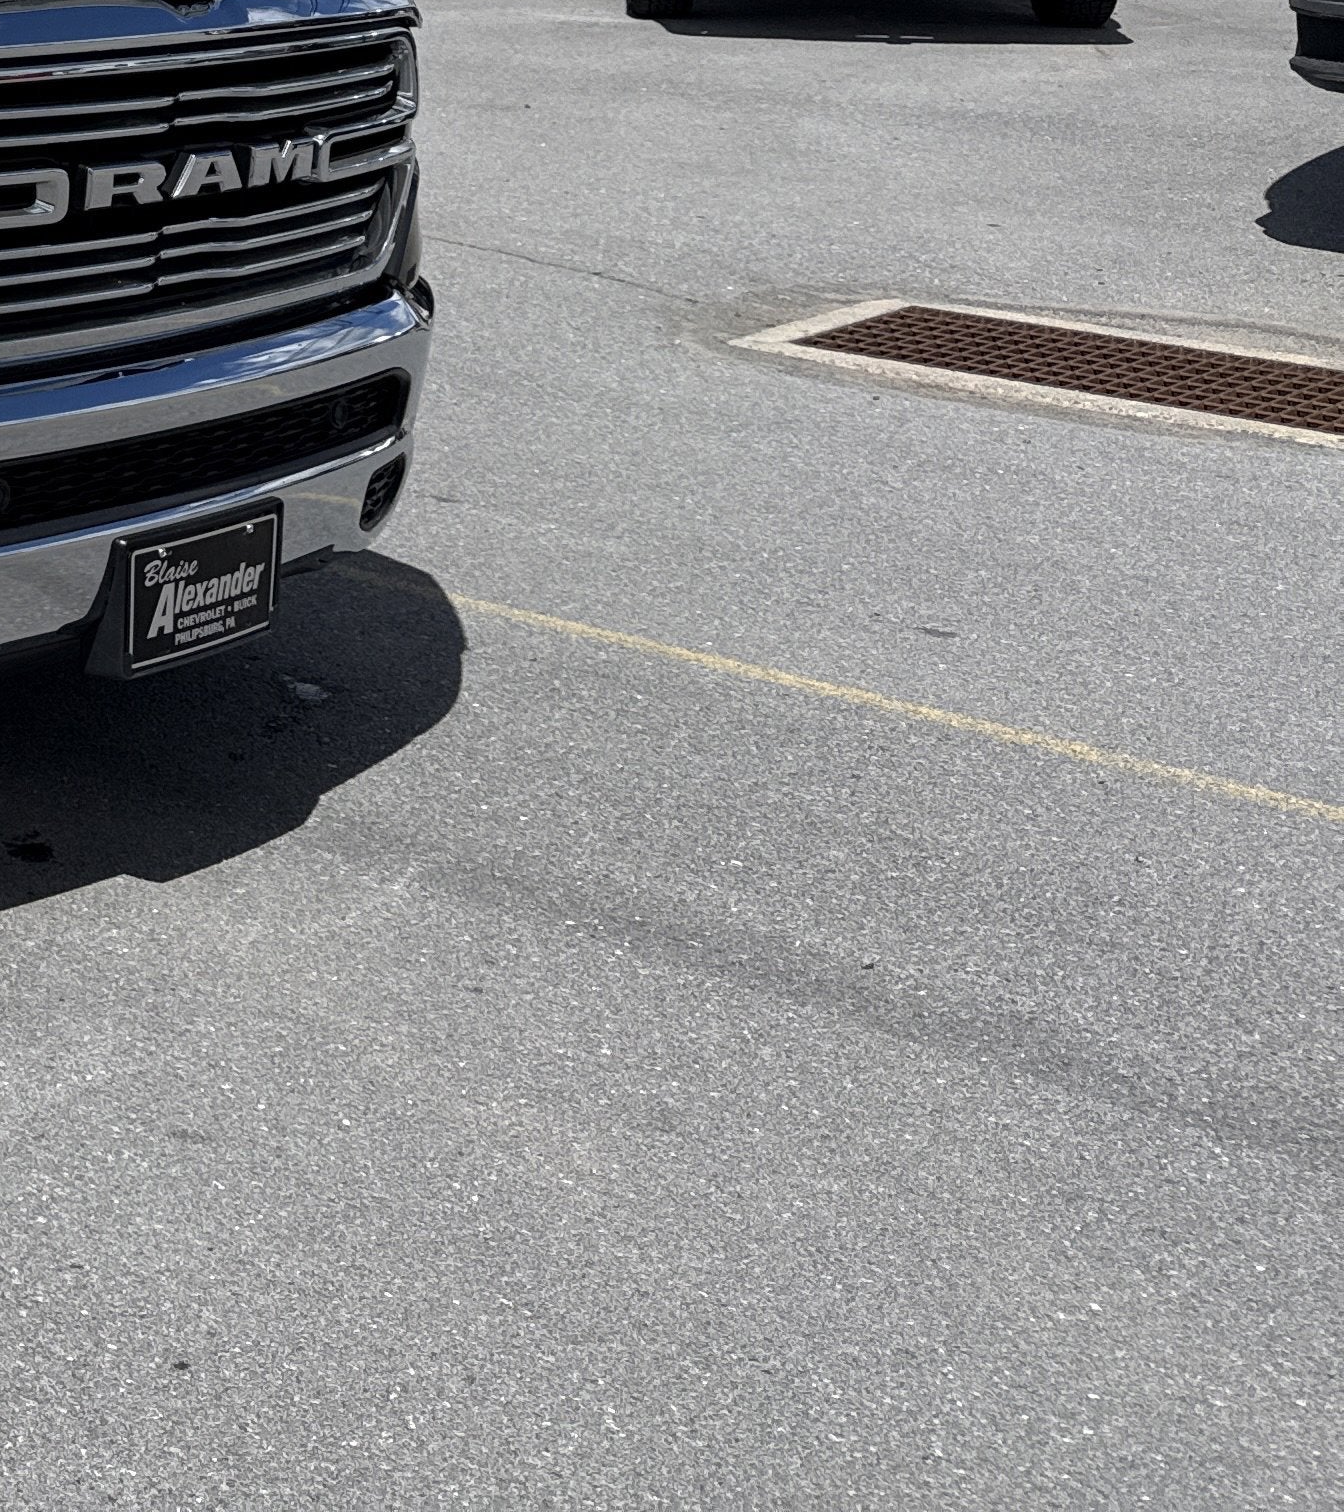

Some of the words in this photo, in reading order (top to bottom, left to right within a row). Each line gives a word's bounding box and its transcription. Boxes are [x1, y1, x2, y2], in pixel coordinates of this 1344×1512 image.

[85, 138, 313, 211] RAM
[144, 559, 198, 587] Blaise
[147, 562, 265, 639] Alexander
[177, 605, 225, 629] CHEVROLET
[233, 594, 257, 612] BUICK
[225, 616, 236, 629] PA
